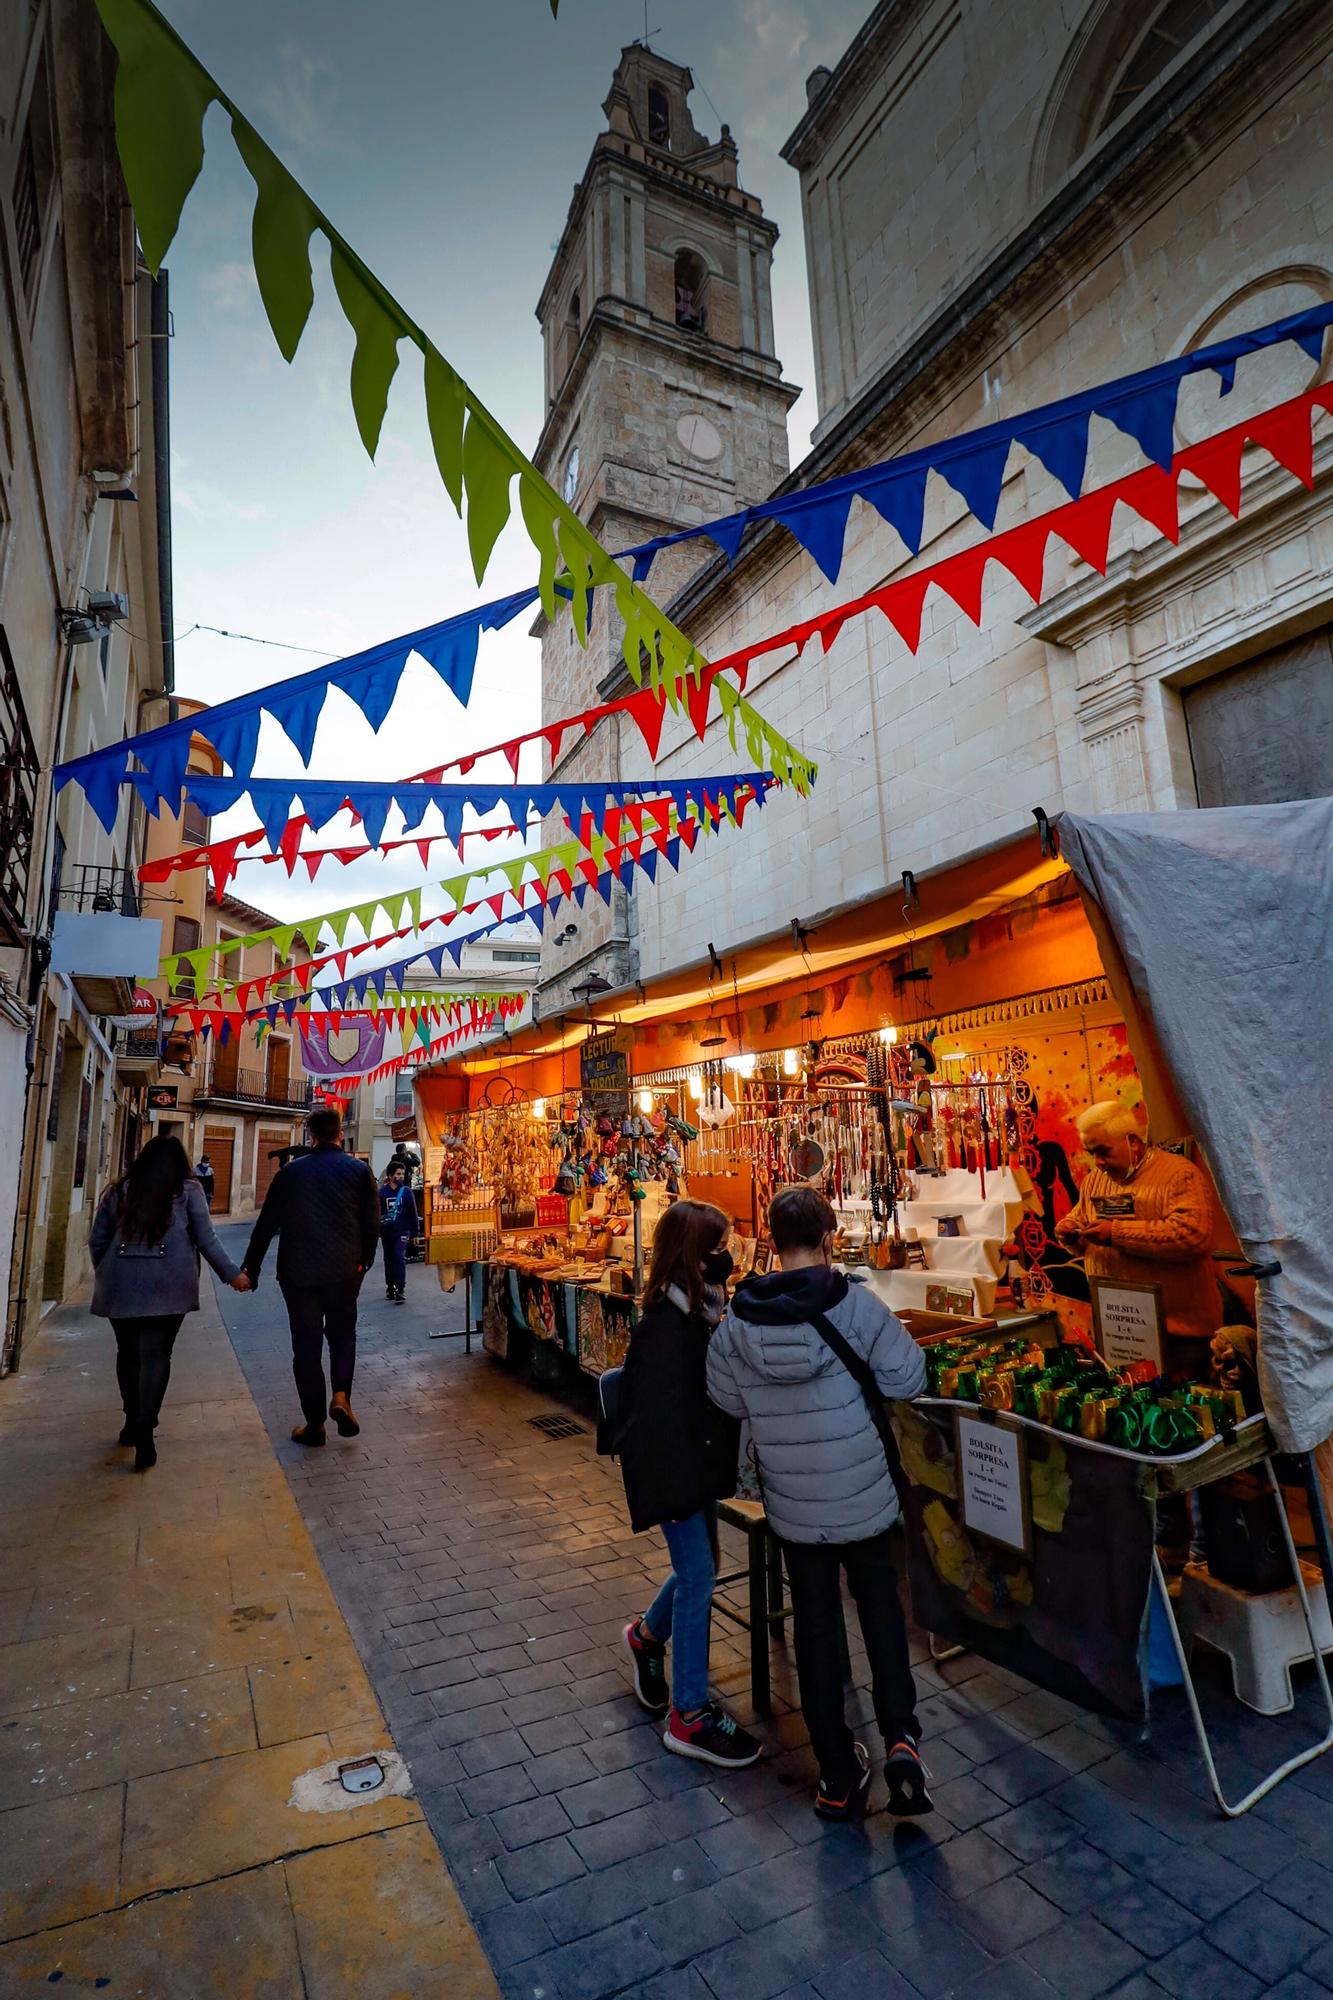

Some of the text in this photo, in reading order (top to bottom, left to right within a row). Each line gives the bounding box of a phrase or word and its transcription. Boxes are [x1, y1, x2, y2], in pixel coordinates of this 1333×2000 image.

[133, 999, 152, 1008] AR
[596, 1060, 609, 1071] DEL
[589, 1074, 617, 1089] TAROT
[1107, 1303, 1140, 1314] BOLSITA
[1105, 1313, 1147, 1326] SORPRESA
[969, 1438, 1003, 1455] BOLSITA
[967, 1449, 1009, 1469] SORPRESA
